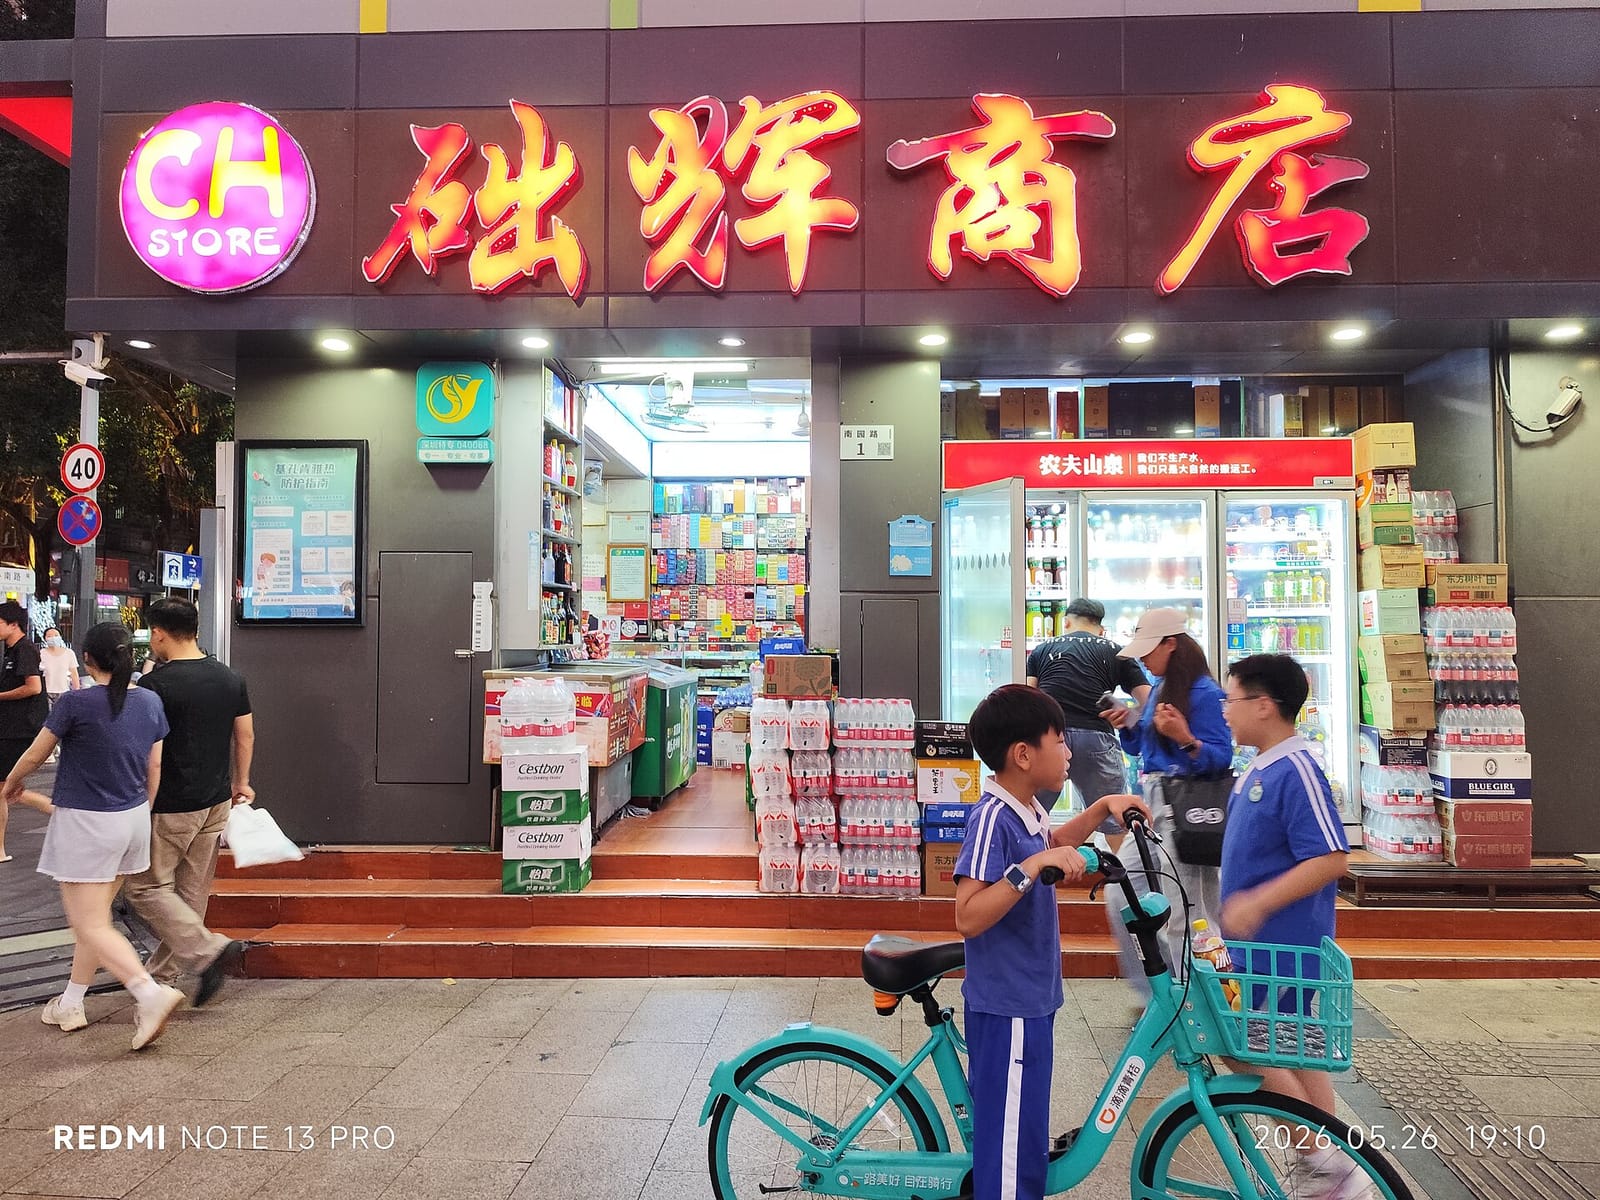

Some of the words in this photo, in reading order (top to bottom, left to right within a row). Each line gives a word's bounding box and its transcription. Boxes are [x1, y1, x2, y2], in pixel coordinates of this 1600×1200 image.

[136, 126, 284, 220] CH
[361, 83, 1370, 298] 础辉商店
[148, 227, 280, 257] STORE
[844, 430, 878, 438] 南园路
[857, 443, 865, 455] 1
[71, 457, 96, 480] 40
[1039, 453, 1124, 476] 农夫山泉
[1109, 1063, 1141, 1110] 滴滴青桔
[852, 1172, 901, 1186] 一路美好
